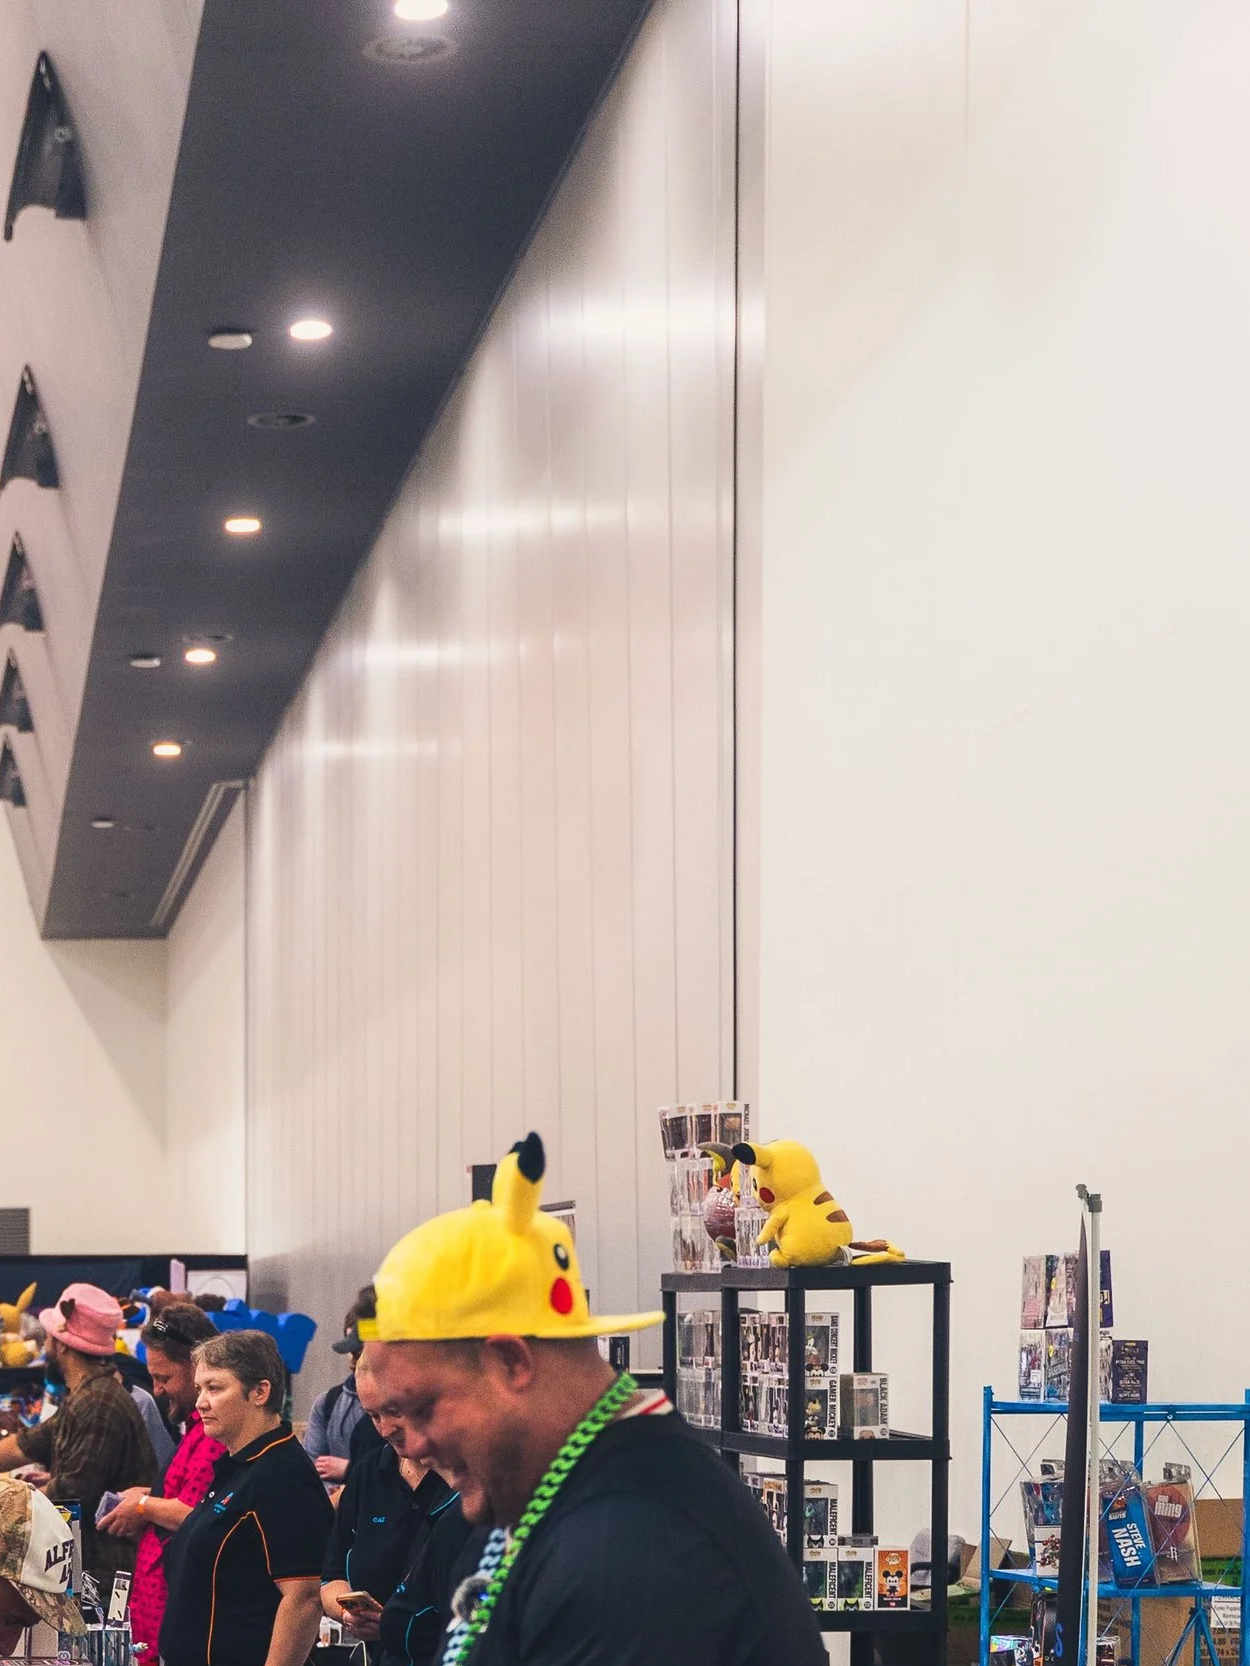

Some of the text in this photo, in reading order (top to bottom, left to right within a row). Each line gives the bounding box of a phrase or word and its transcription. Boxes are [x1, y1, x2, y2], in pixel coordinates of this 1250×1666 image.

[828, 1380, 837, 1429] GAMER MICKEY
[879, 1377, 888, 1425] BLACK ADAM
[828, 1498, 837, 1536] MALEFICENT
[1154, 1501, 1183, 1518] ming
[1111, 1527, 1142, 1568] NASH
[1126, 1522, 1147, 1550] STEVE
[828, 1561, 837, 1600] MALEFICENT
[864, 1561, 873, 1600] MALEFICENT
